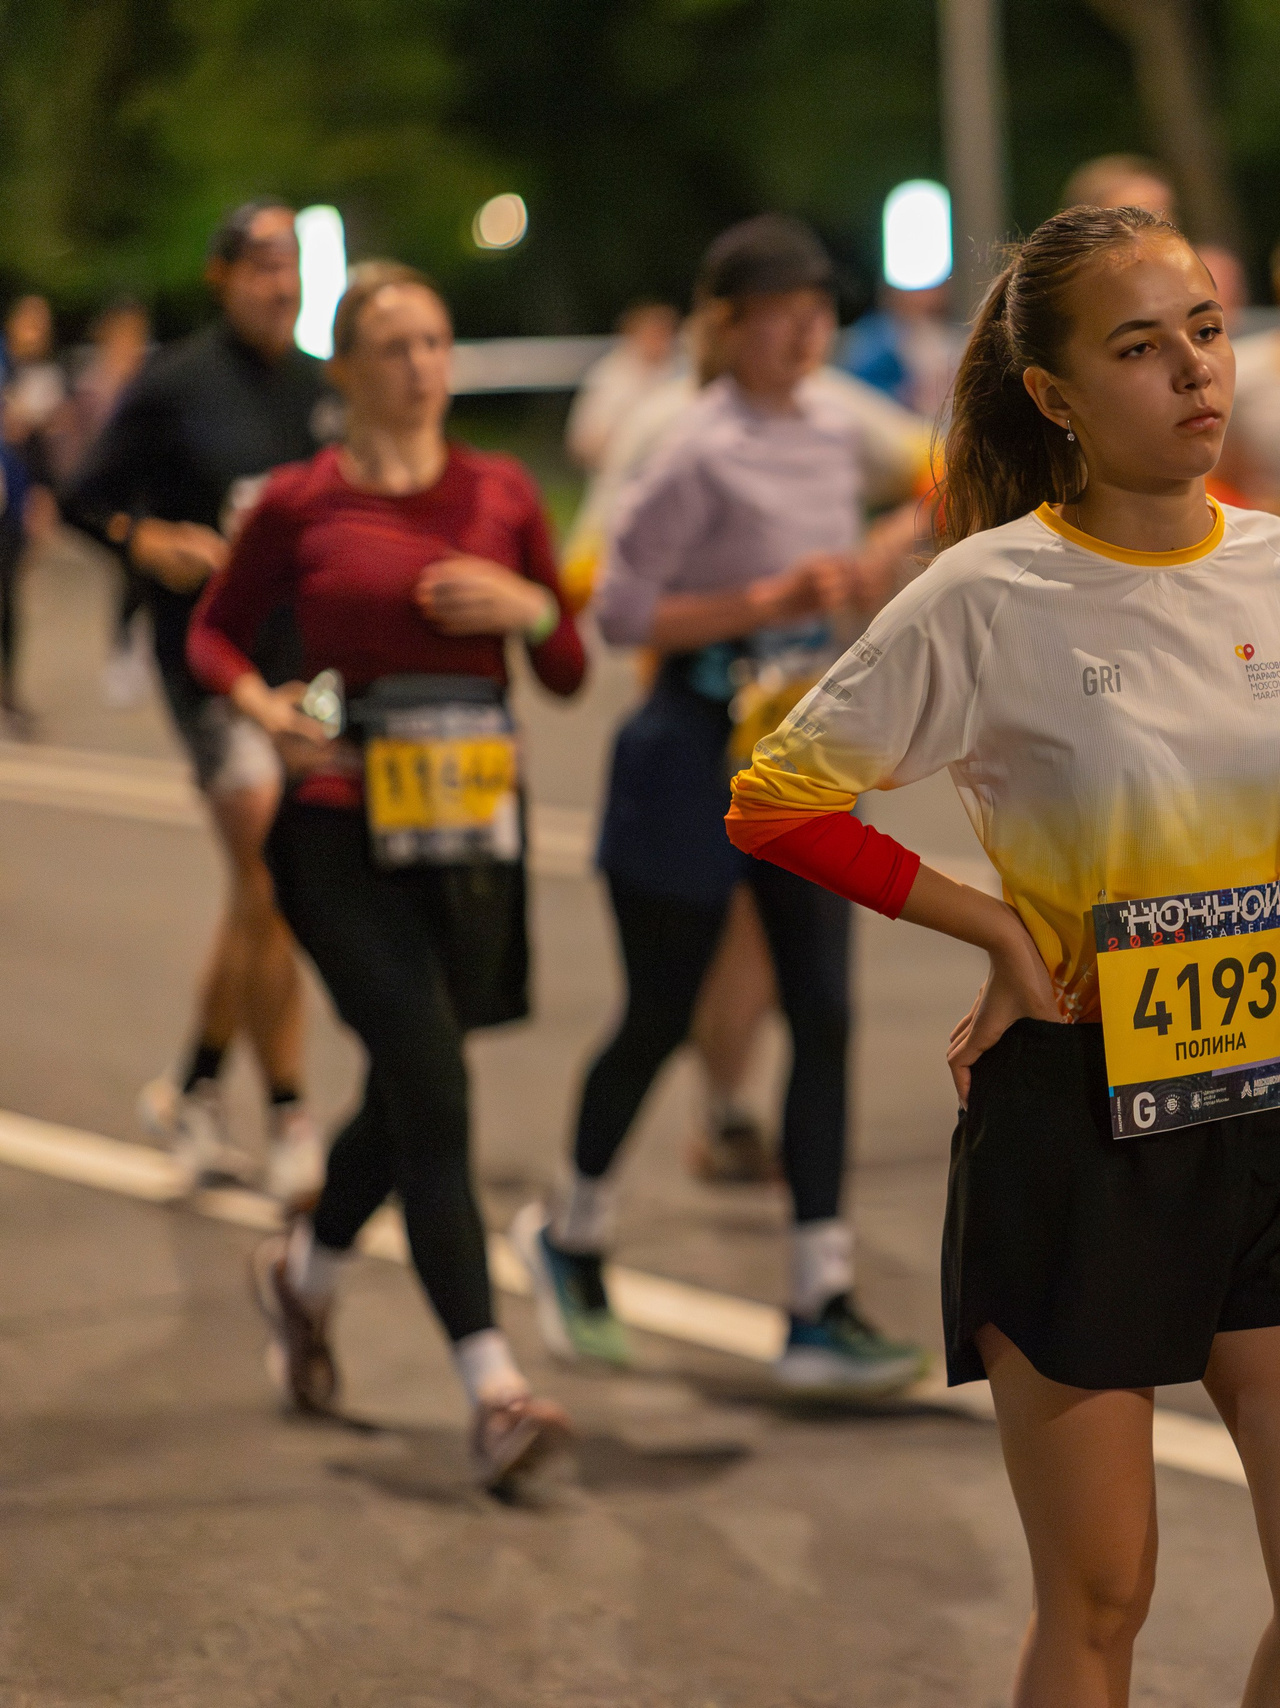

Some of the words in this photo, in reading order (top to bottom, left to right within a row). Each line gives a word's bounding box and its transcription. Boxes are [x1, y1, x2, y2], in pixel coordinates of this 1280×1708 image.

[1107, 928, 1186, 951] 2025
[1206, 921, 1265, 940] ЗАБЕГ
[1133, 951, 1277, 1036] 4193
[1175, 1031, 1247, 1061] ПОЛИНА
[1132, 1091, 1157, 1129] G
